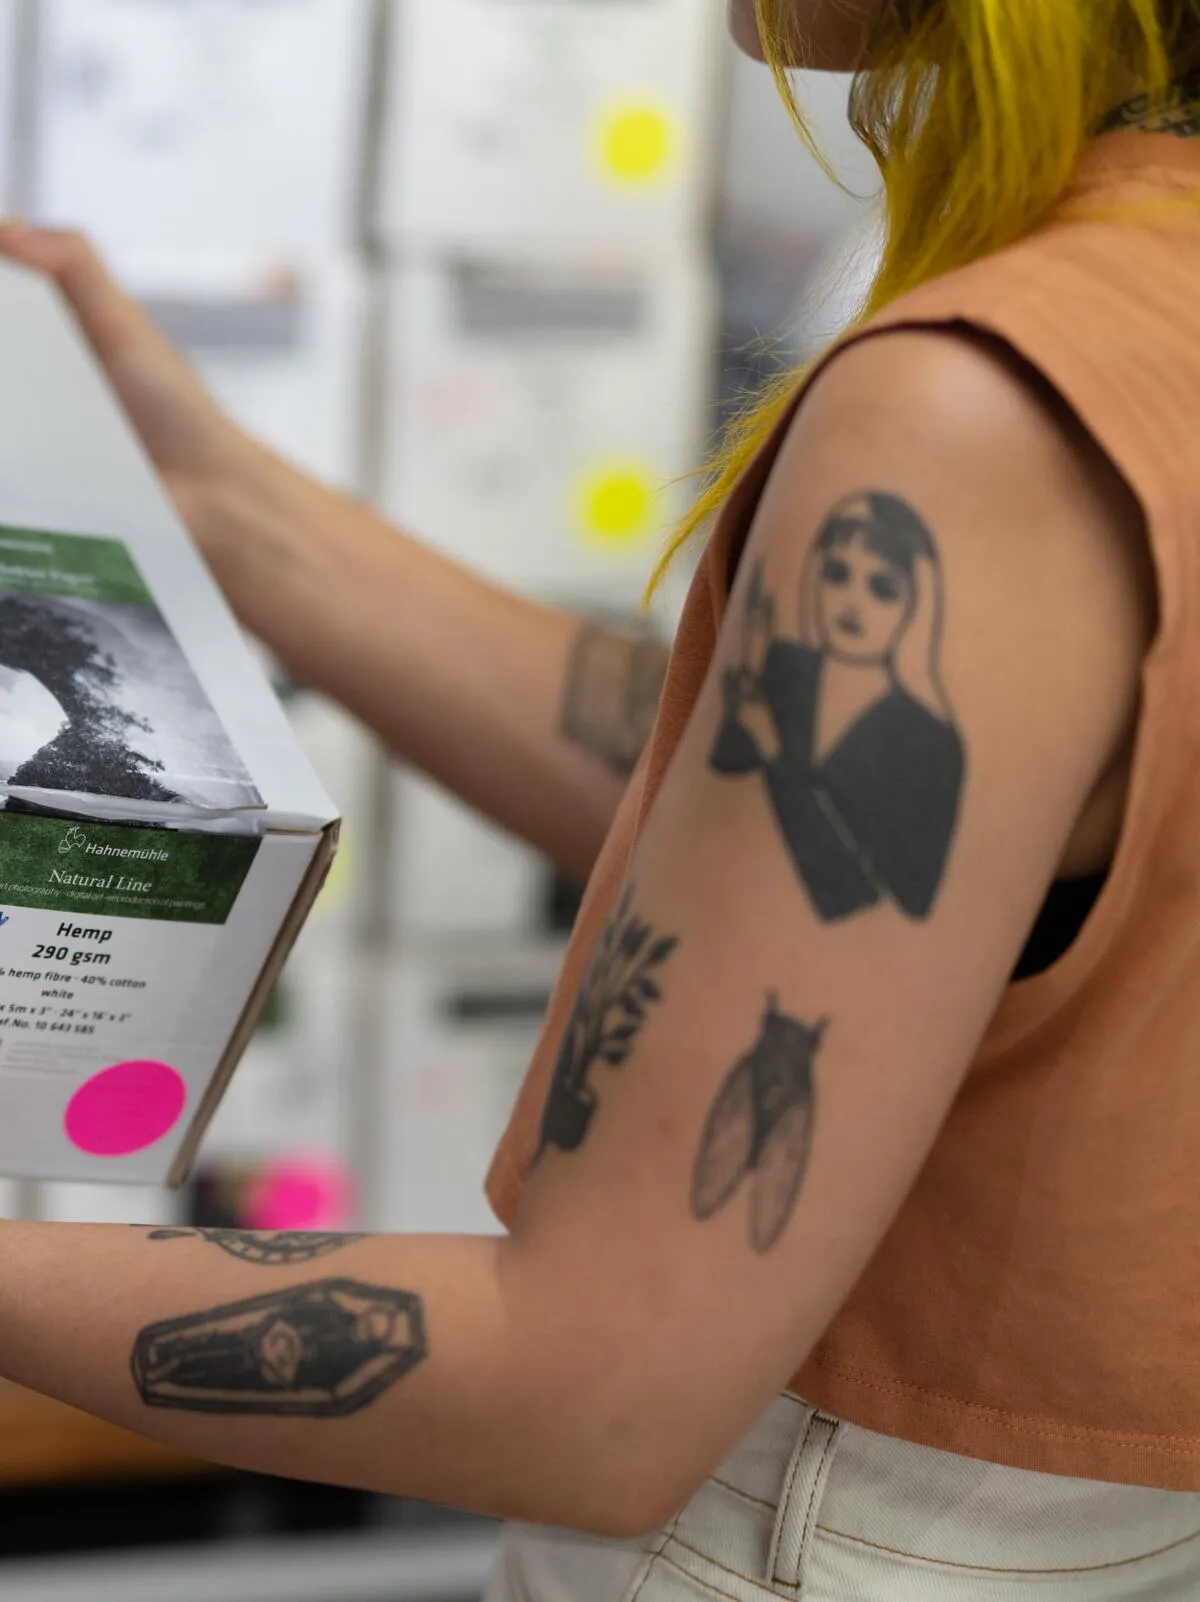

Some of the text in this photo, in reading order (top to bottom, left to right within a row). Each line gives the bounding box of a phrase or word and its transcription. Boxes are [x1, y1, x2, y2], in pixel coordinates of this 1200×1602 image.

[85, 842, 169, 861] Hahnemühle
[48, 869, 152, 893] Natural Line
[56, 922, 113, 944] Hemp
[31, 944, 111, 966] 290 gsm
[8, 968, 42, 981] hemp
[44, 971, 72, 982] fibre
[81, 975, 107, 986] 40%
[109, 978, 146, 989] cotton
[41, 989, 74, 999] white
[8, 1004, 27, 1013] 5m
[36, 1021, 48, 1031] 10
